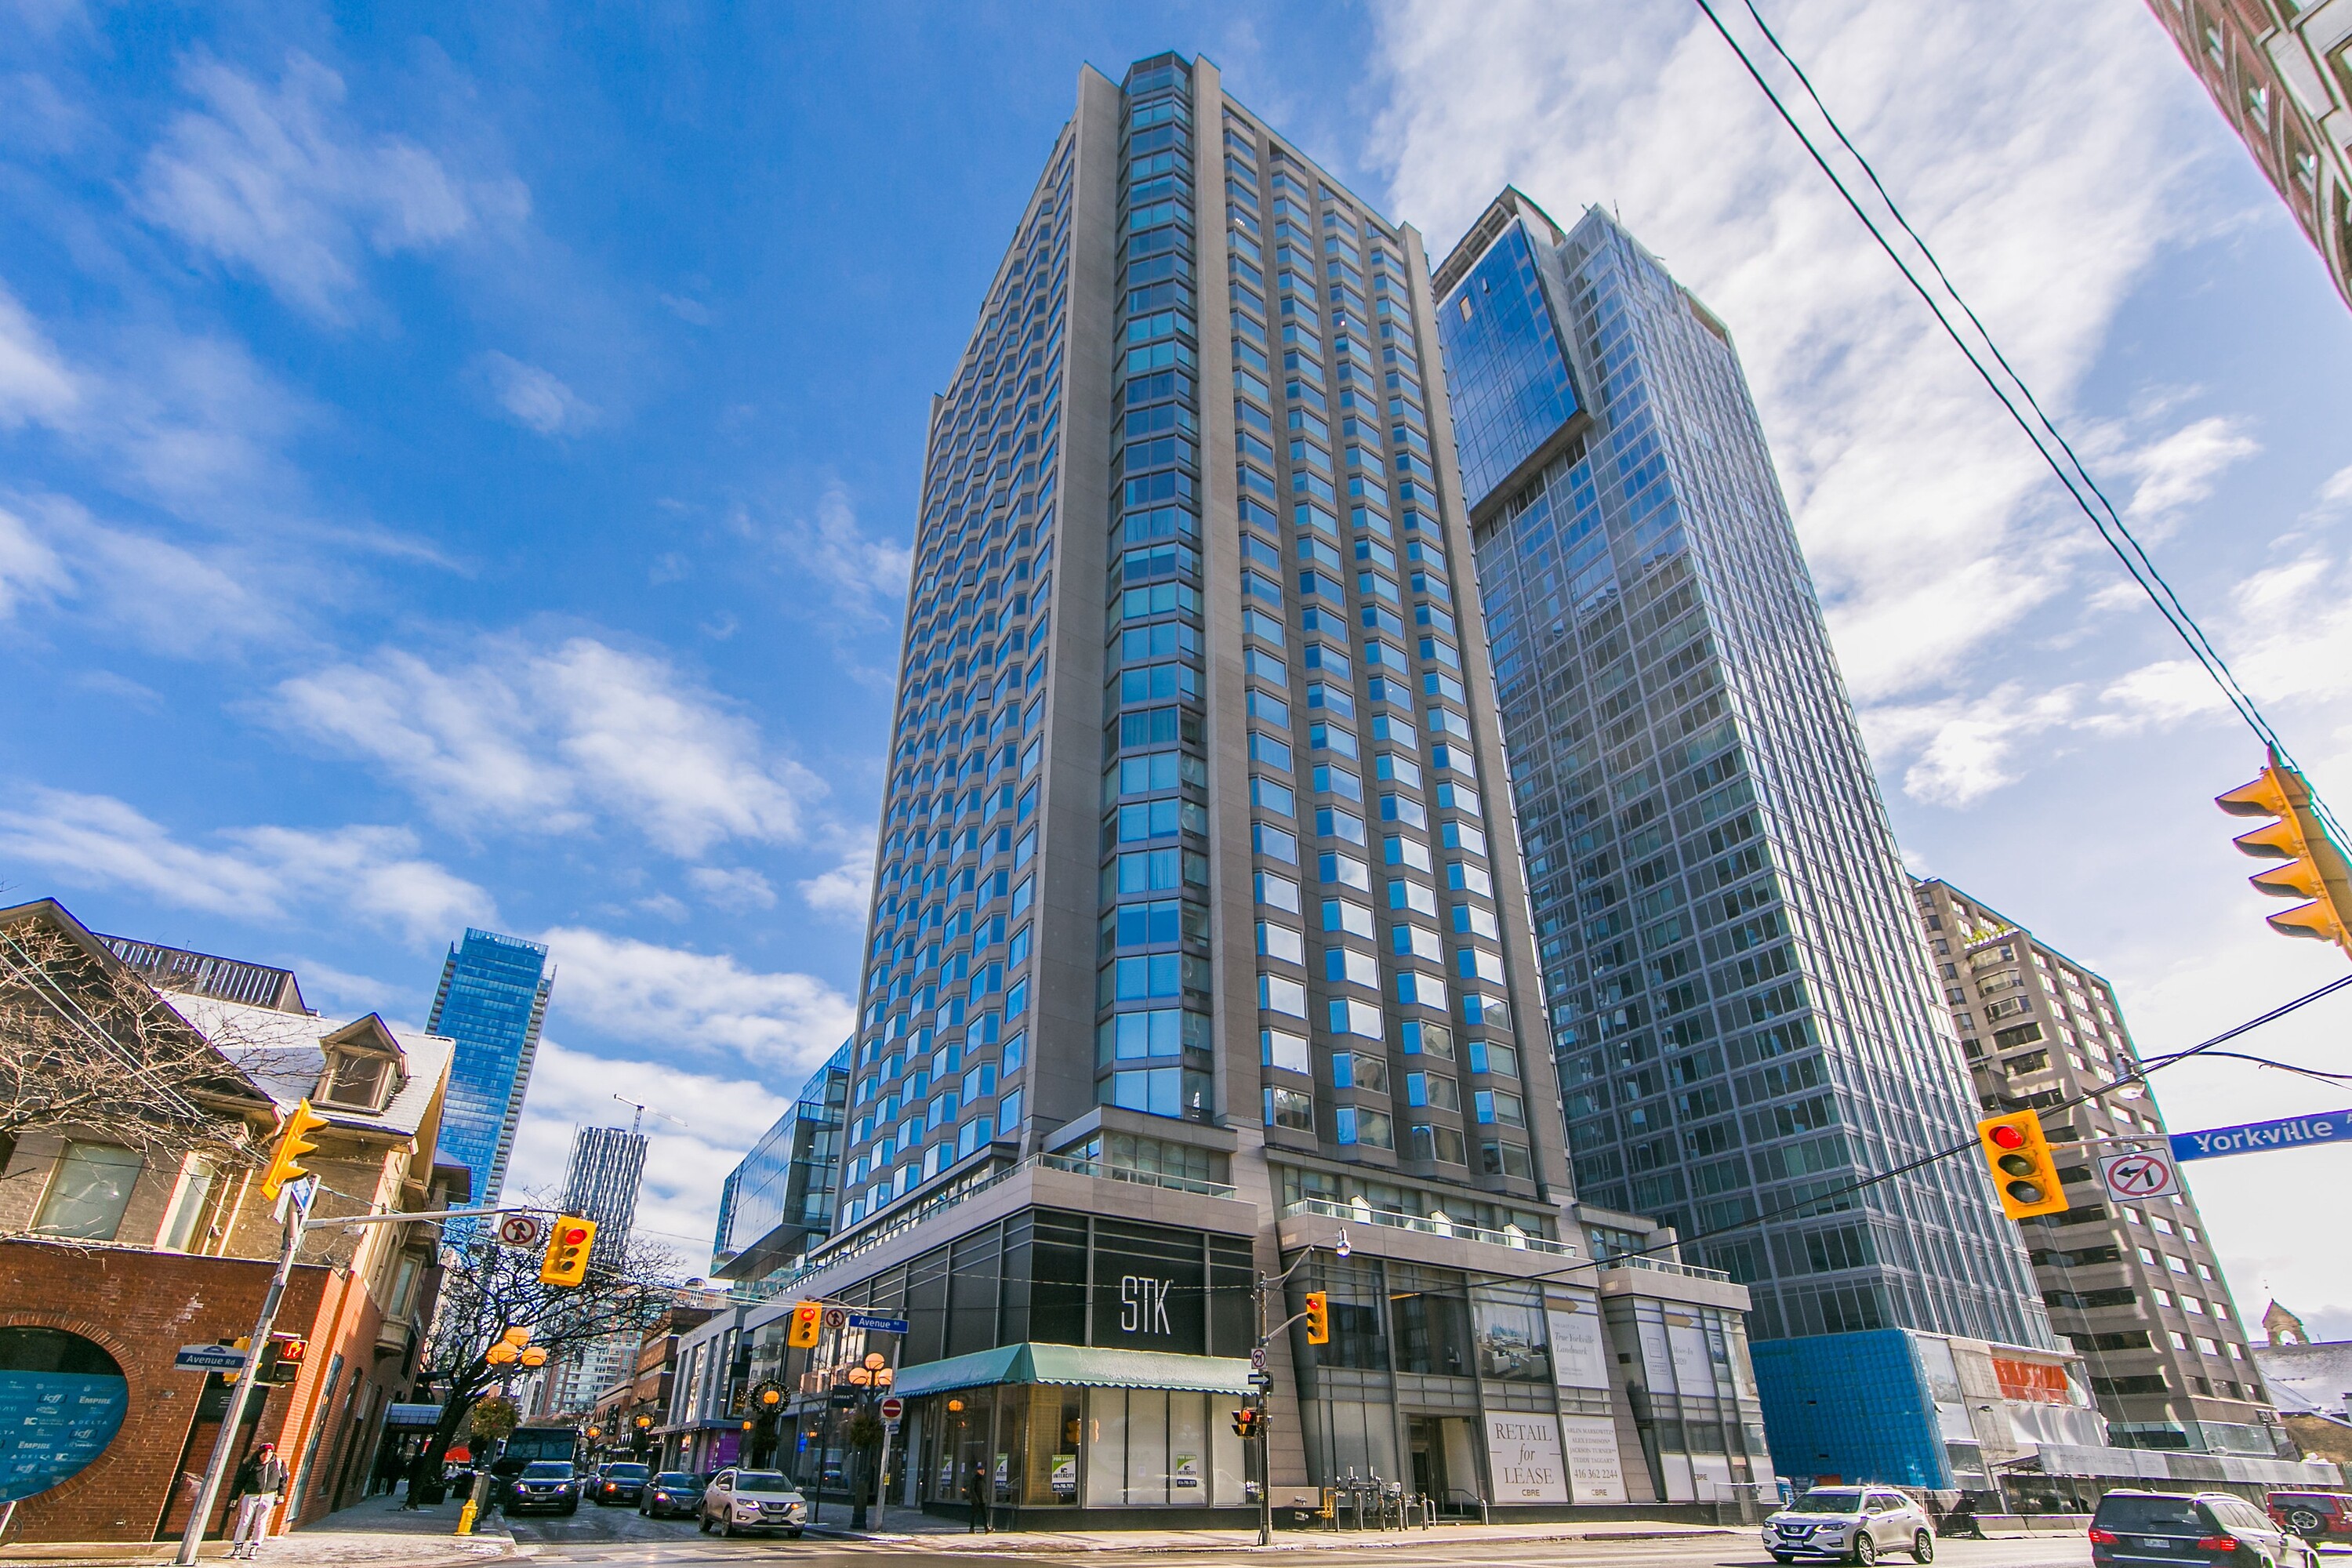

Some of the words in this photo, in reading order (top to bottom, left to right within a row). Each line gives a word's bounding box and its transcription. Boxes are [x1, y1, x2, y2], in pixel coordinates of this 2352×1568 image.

[2194, 1120, 2333, 1152] Yorkville
[1121, 1275, 1171, 1335] STK
[858, 1318, 891, 1328] Avenue
[1555, 1332, 1568, 1342] True
[1569, 1334, 1595, 1344] Yorkville
[1556, 1344, 1588, 1356] Landmark
[186, 1355, 223, 1364] Avenue
[43, 1393, 63, 1403] icff
[78, 1396, 113, 1404] EMPIRE
[1495, 1422, 1552, 1441] RETAIL
[18, 1440, 52, 1449] EMPIRE
[1518, 1443, 1536, 1465] for
[1504, 1467, 1555, 1484] LEASE
[1574, 1468, 1586, 1479] 416
[1588, 1468, 1600, 1479] 362
[1602, 1468, 1618, 1479] 2244
